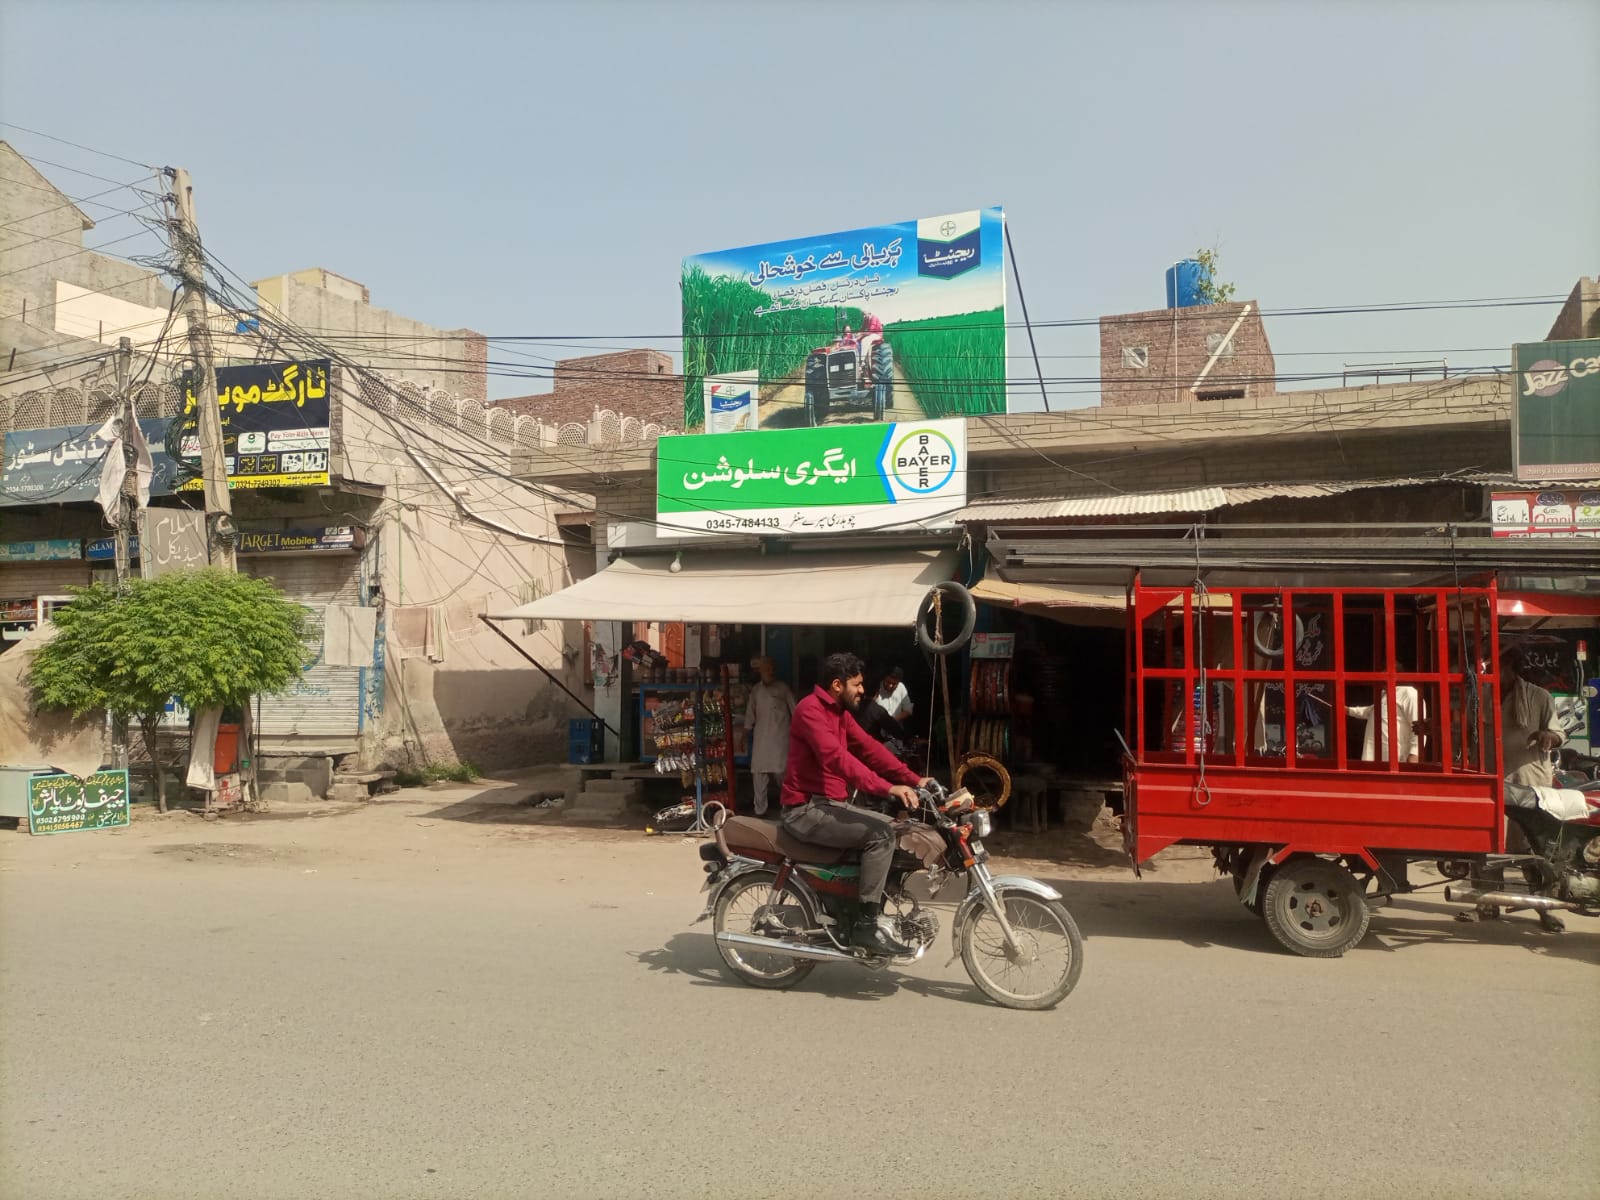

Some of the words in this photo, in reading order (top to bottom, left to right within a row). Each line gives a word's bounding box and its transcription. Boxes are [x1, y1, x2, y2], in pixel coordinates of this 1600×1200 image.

[749, 254, 817, 287] خوشحالی
[819, 249, 849, 270] سے
[924, 247, 976, 265] ریجنٹ
[261, 364, 327, 408] ٹارگٹ
[1523, 365, 1569, 396] Jazz
[6, 441, 52, 471] سٹور
[784, 447, 858, 488] ایگری
[898, 455, 951, 468] BAYER
[918, 434, 931, 489] BAYER
[683, 456, 782, 491] سلوشن
[156, 514, 199, 546] اسلام
[706, 518, 780, 529] 0345-7484133
[88, 543, 113, 552] ISLAM
[157, 535, 203, 567] میڈیکل
[239, 532, 280, 552] TARGET
[280, 536, 317, 546] Mobiles
[85, 788, 125, 808] چیف
